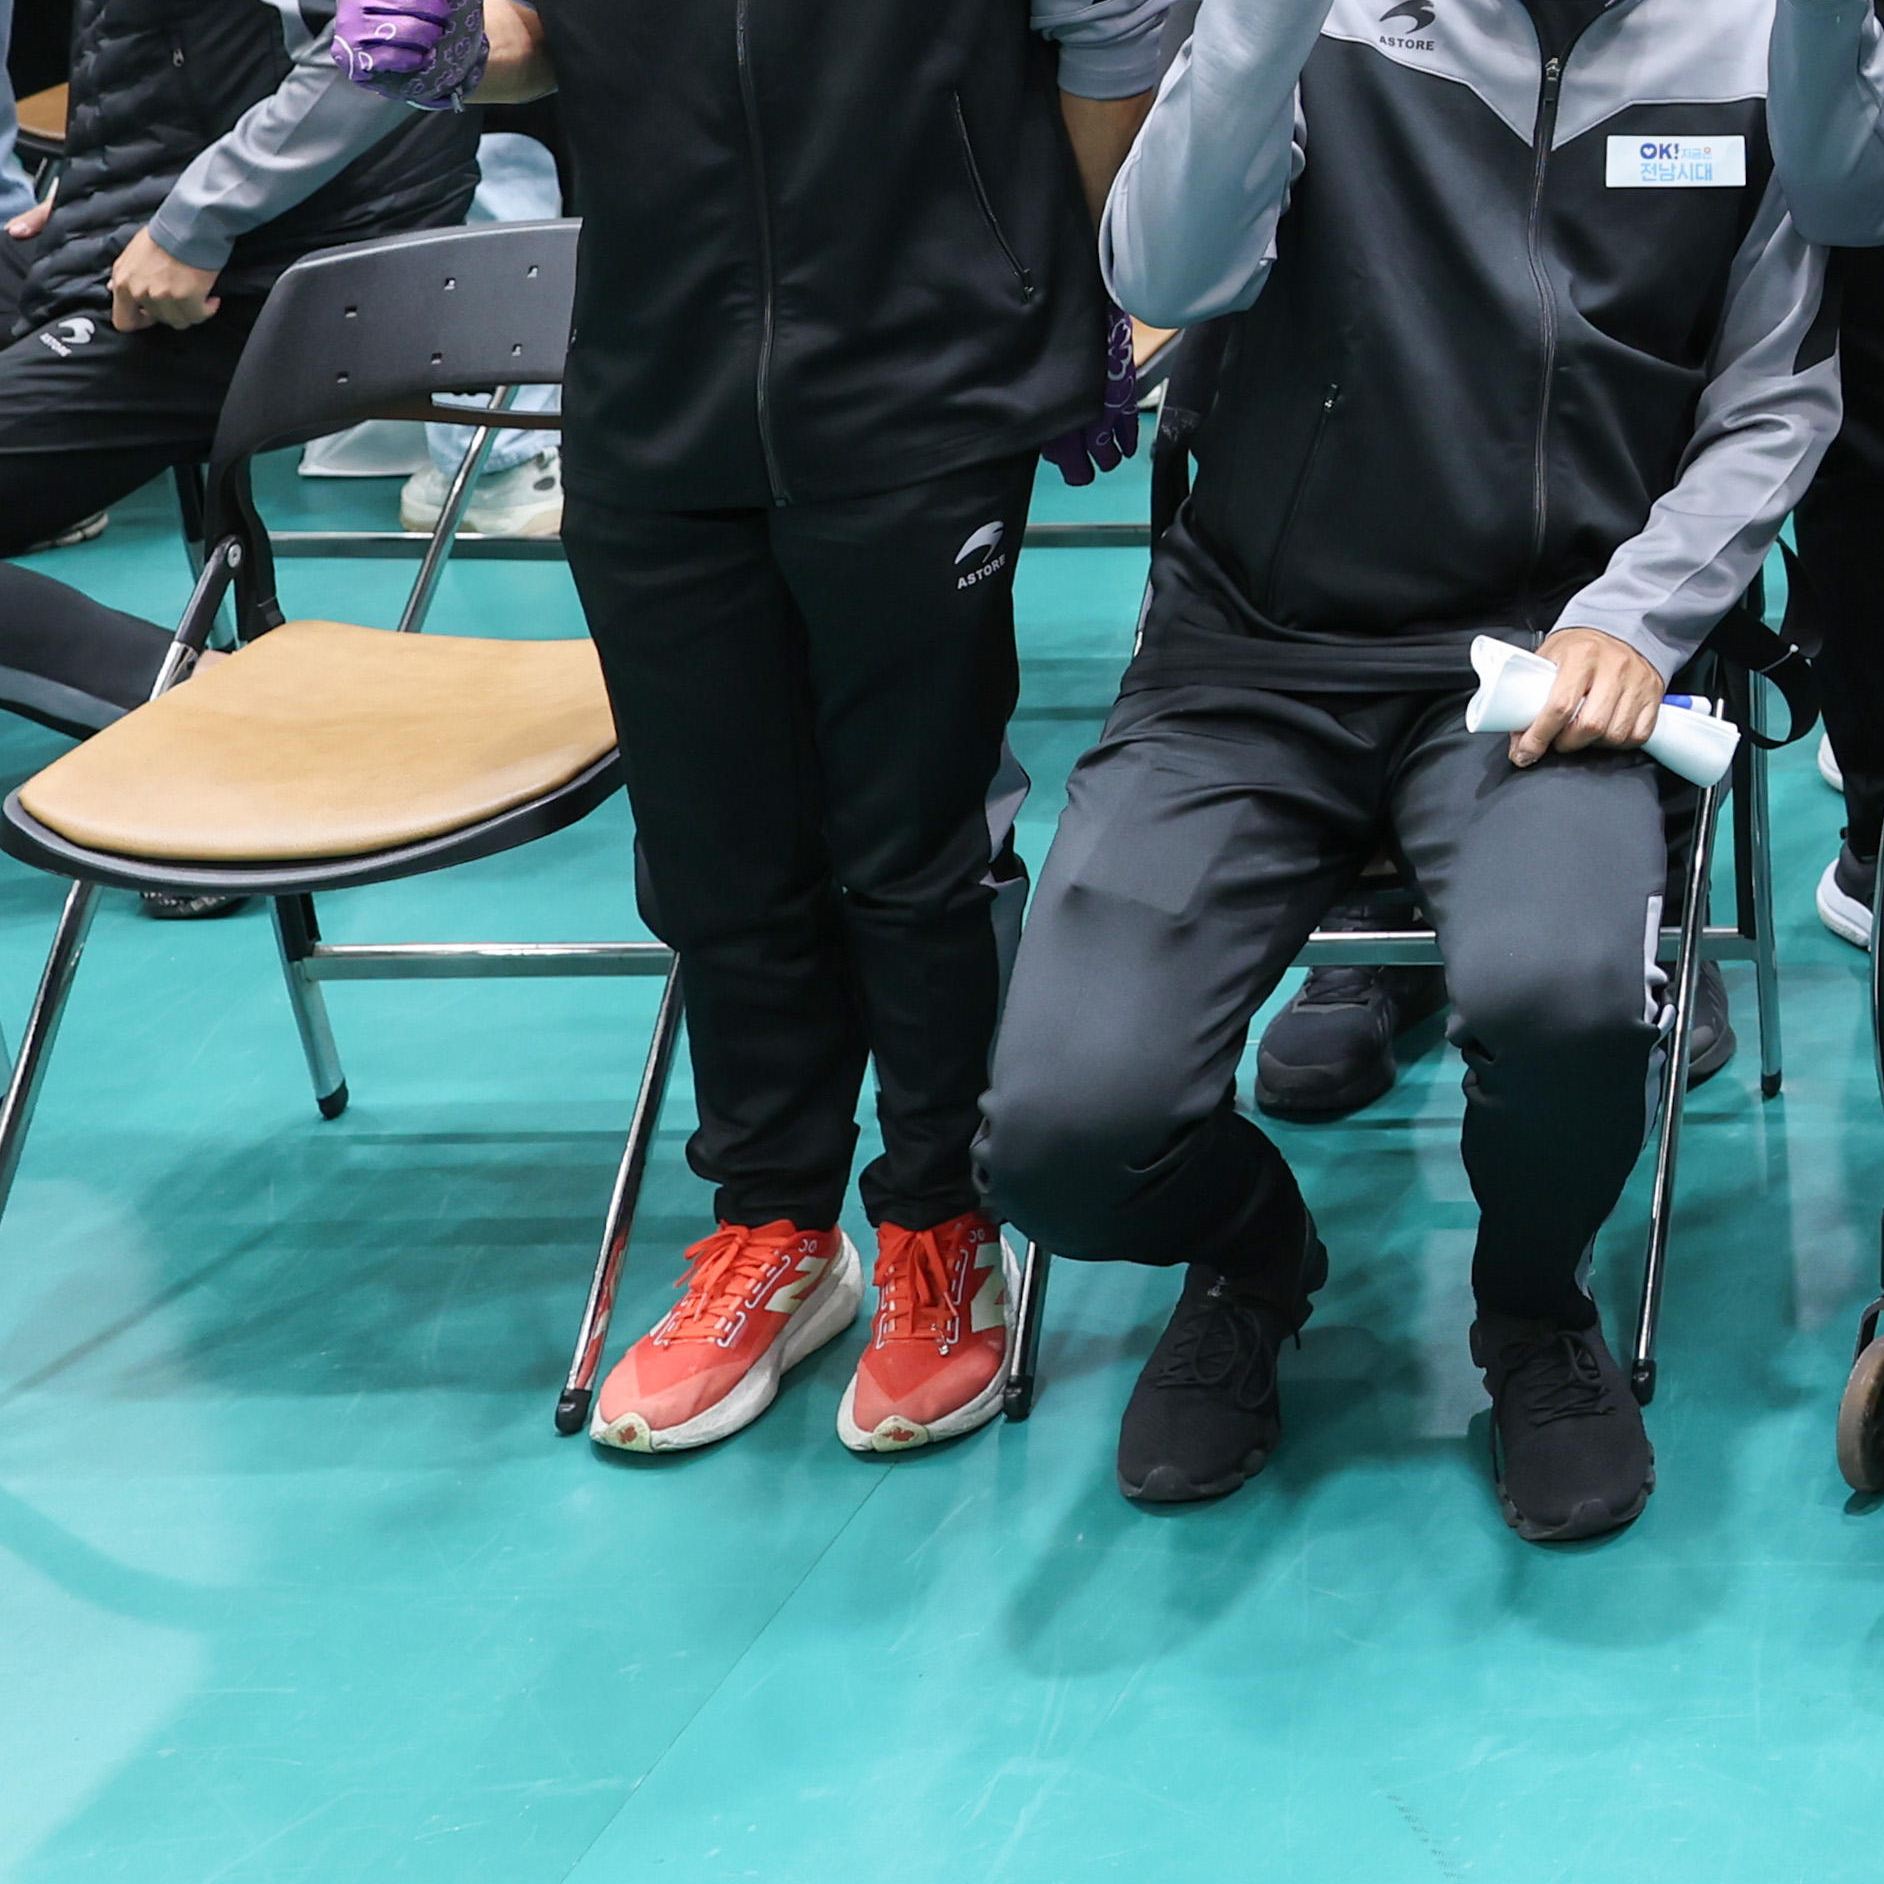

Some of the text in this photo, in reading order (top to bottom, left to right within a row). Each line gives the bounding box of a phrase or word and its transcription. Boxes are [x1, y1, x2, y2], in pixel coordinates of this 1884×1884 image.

[1379, 35, 1436, 52] ASTORE
[1639, 142, 1680, 160] OK!
[1640, 161, 1714, 182] 전남시대
[957, 553, 1006, 590] ASTORE
